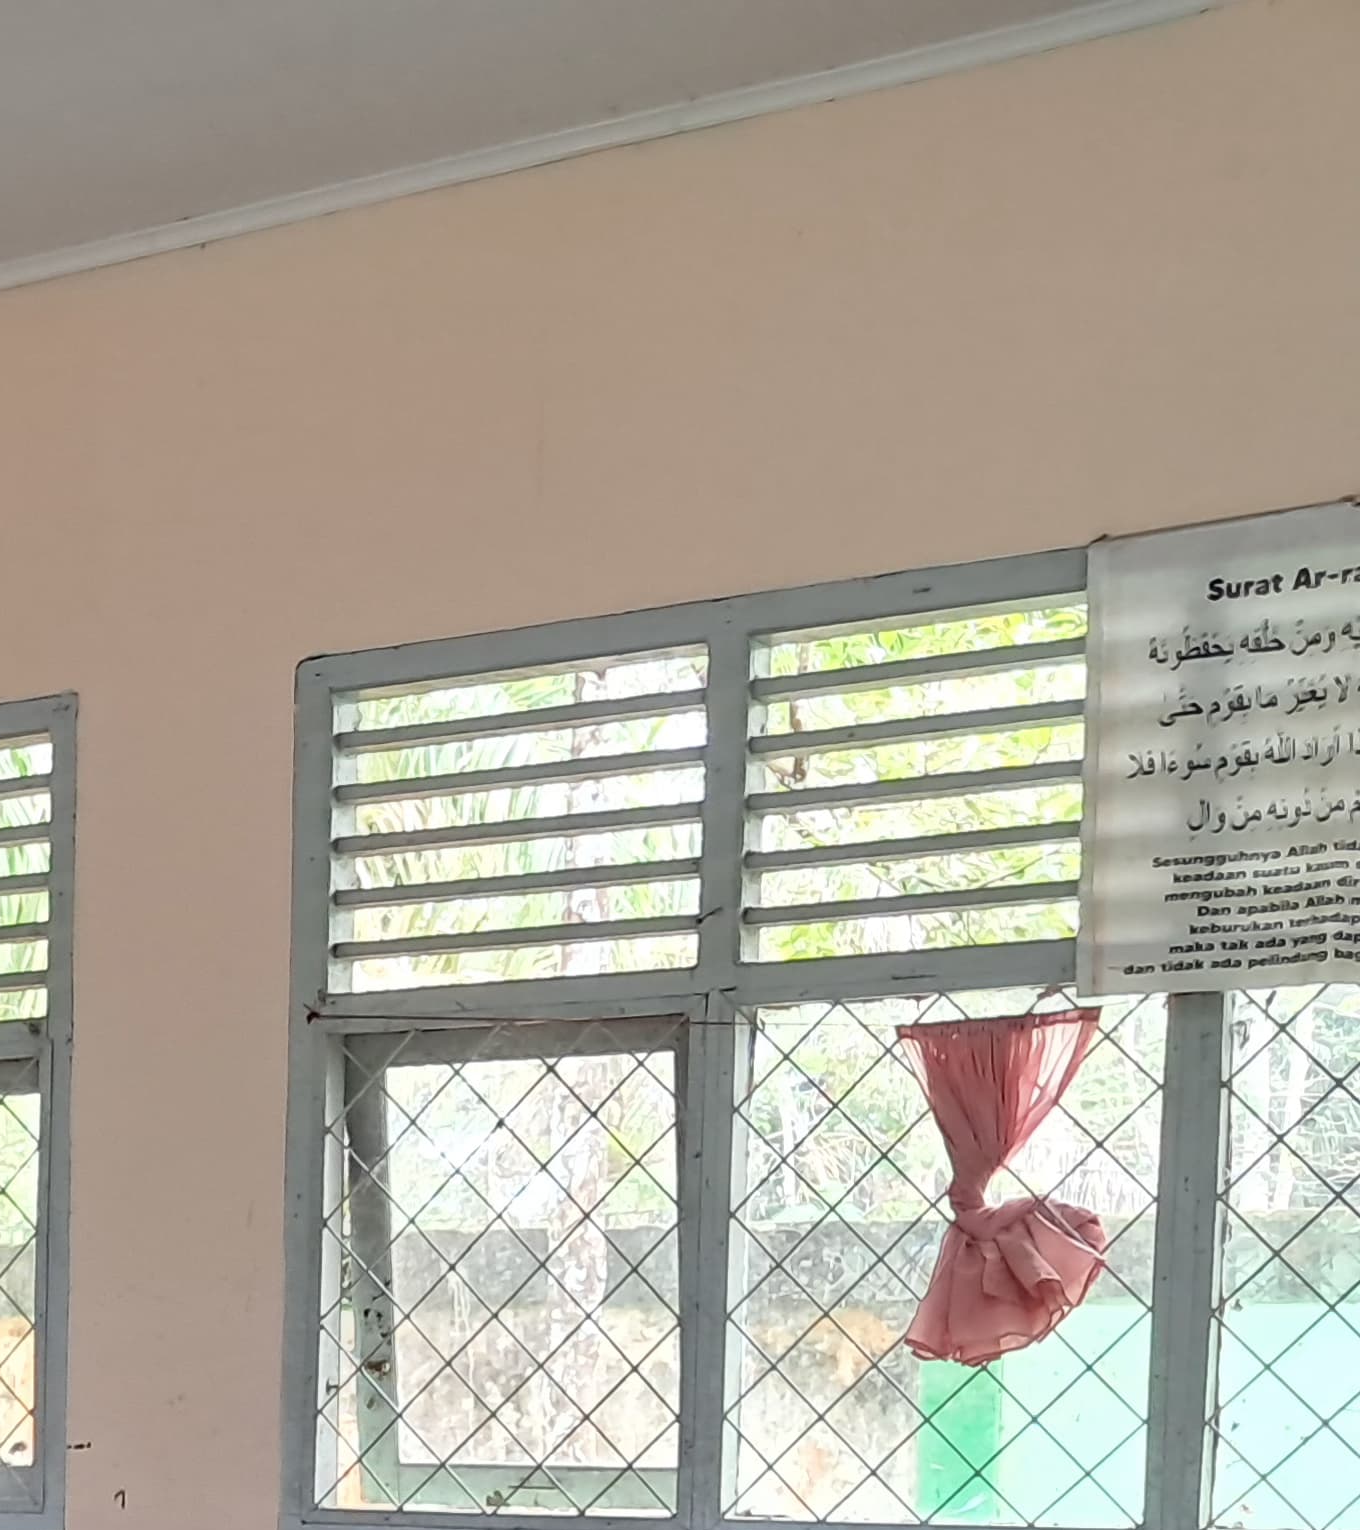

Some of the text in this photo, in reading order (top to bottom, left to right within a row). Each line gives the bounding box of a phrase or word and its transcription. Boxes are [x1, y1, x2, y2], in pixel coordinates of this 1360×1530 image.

[1207, 574, 1283, 601] Surat
[1152, 850, 1281, 869] Sesungguhnya
[1333, 840, 1360, 851] tid
[1173, 869, 1246, 884] keadaan
[1164, 885, 1257, 903] mengubah
[1263, 878, 1331, 895] keadaan
[1197, 904, 1231, 917] Dan
[1189, 920, 1283, 935] keburukan
[1168, 940, 1215, 954] maka
[1221, 939, 1248, 951] tak
[1255, 937, 1286, 949] ada
[1124, 962, 1155, 975] dan
[1210, 956, 1242, 969] ada
